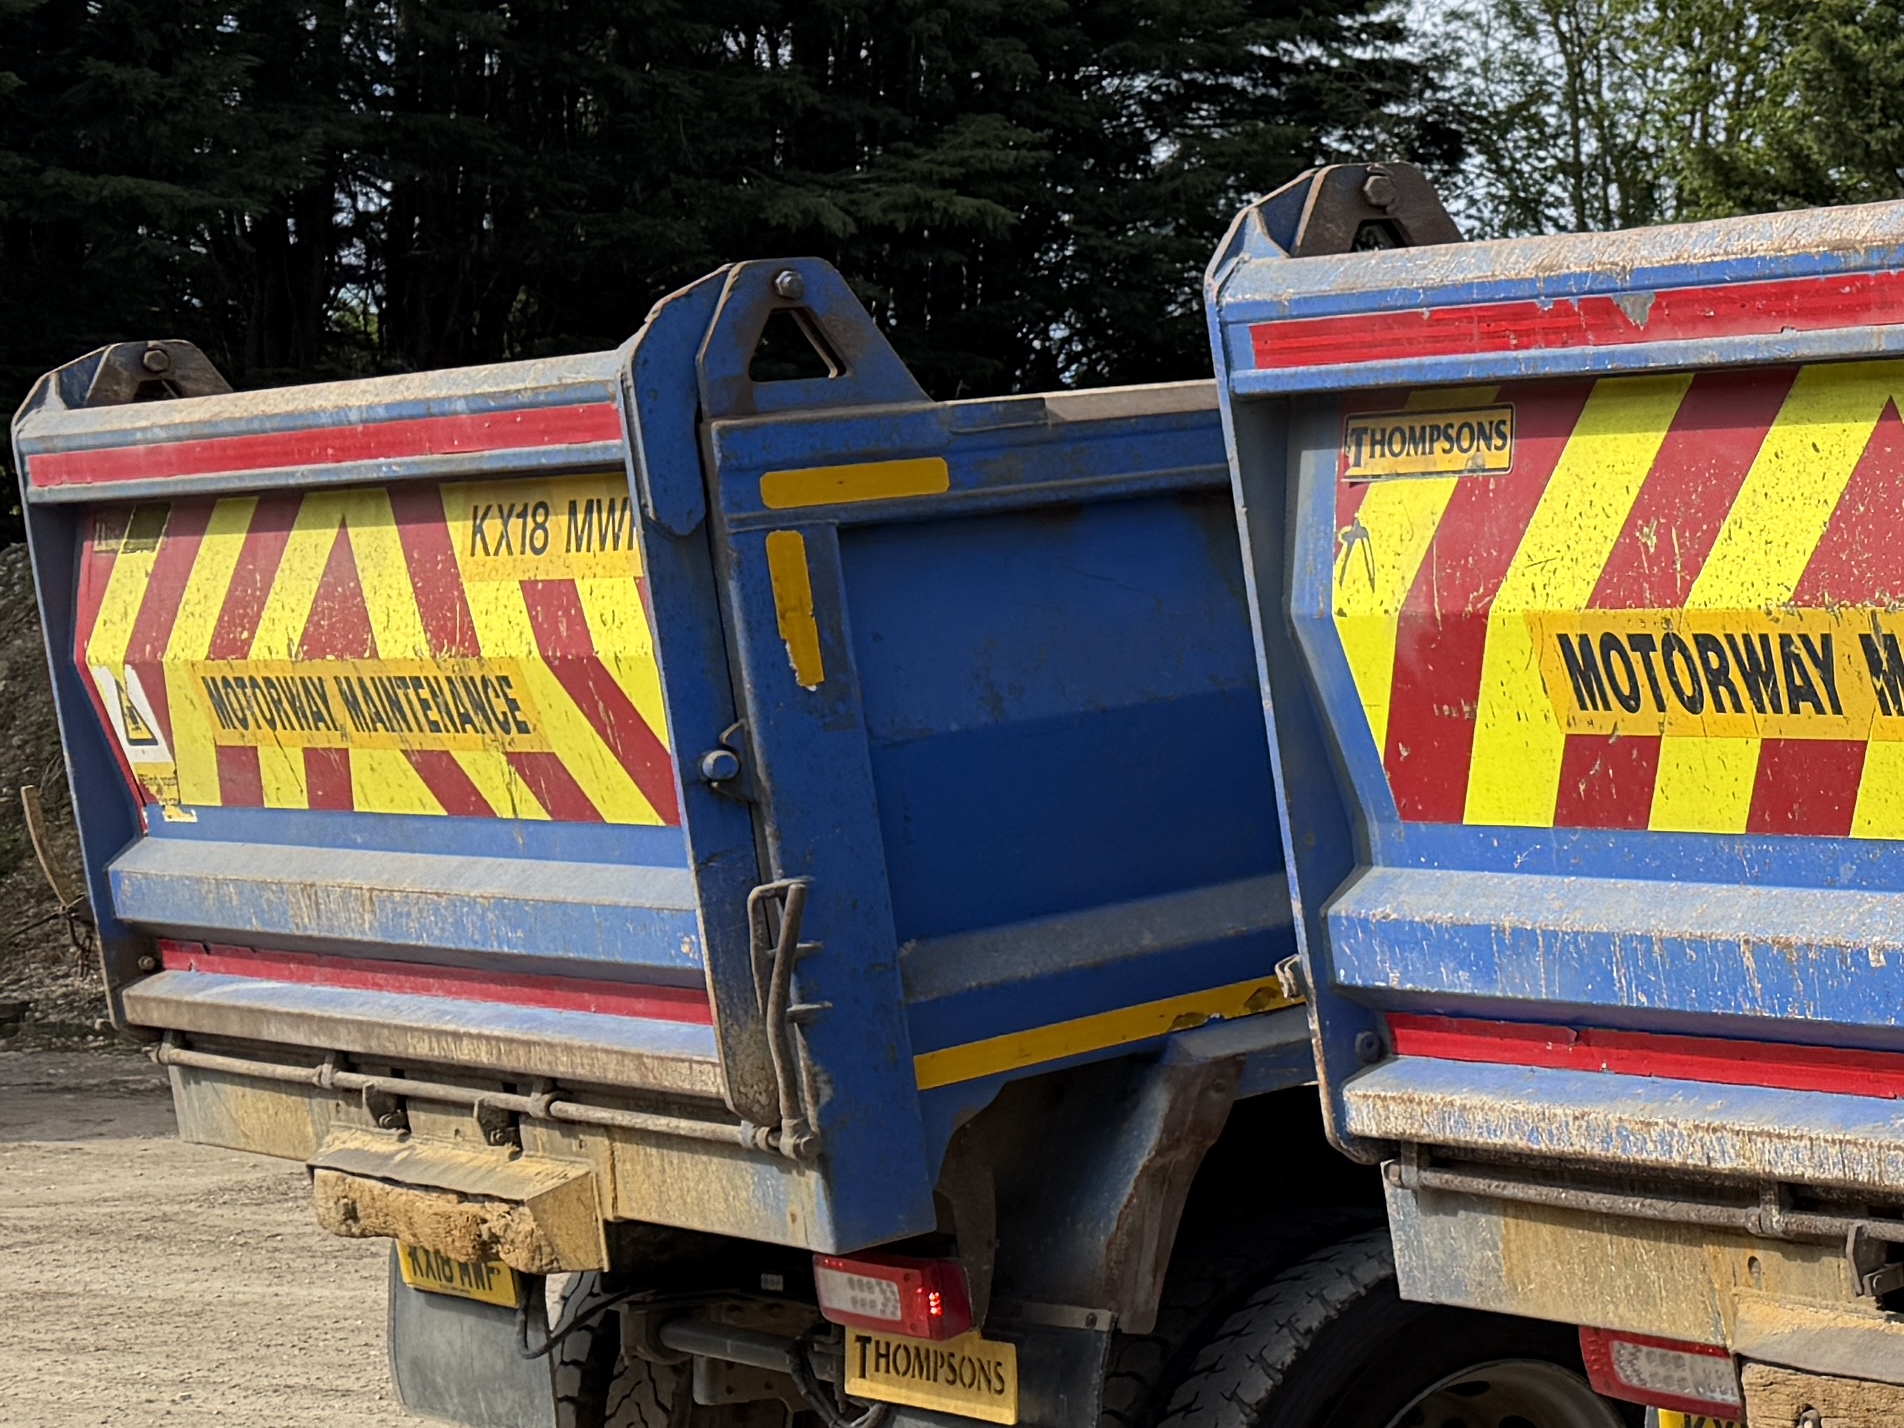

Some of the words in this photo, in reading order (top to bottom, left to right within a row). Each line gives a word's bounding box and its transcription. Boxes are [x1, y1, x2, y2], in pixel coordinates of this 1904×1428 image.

[1350, 419, 1508, 468] THOMPSONS
[470, 500, 550, 558] KX18
[565, 496, 636, 553] MW
[1556, 631, 1844, 716] MOTORWAY
[201, 674, 341, 732] MOTORWAY
[334, 674, 532, 736] MAINTENANCE
[855, 1335, 1005, 1395] THOMPSONS
